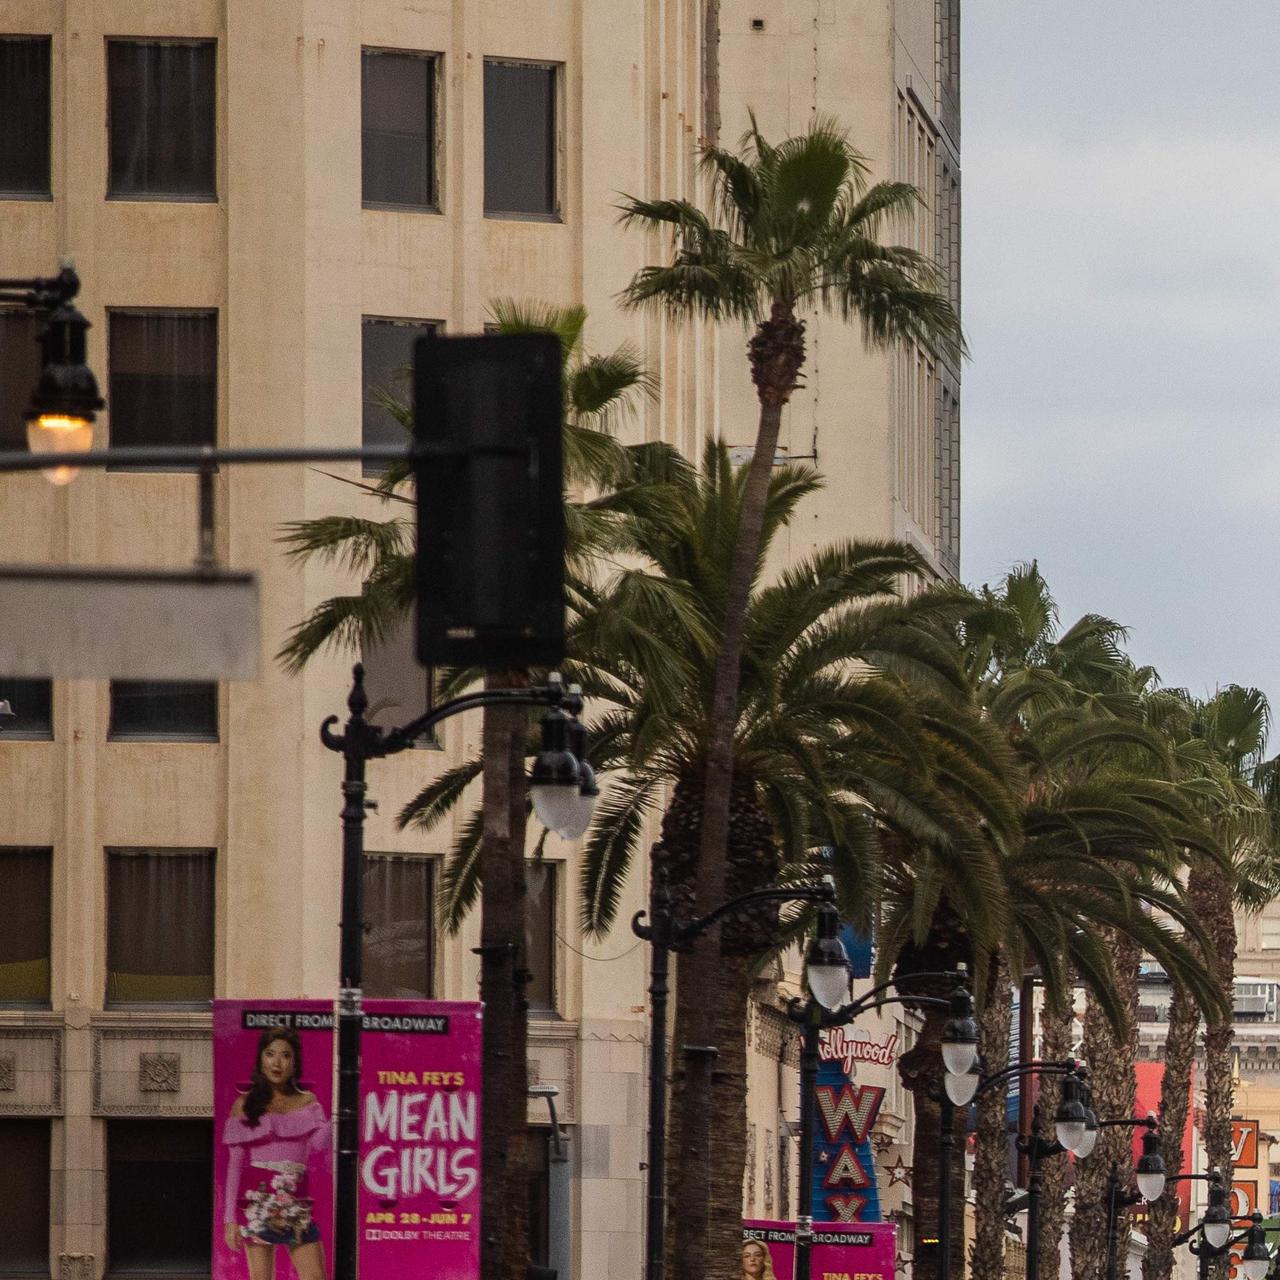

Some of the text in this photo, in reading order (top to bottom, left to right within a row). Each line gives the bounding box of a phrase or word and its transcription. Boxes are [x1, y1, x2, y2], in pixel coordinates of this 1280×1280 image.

[246, 1013, 446, 1032] DIRECT FROM BROADWAY
[816, 1027, 897, 1073] ollywood
[377, 1071, 465, 1087] TINA FEY'S
[364, 1090, 477, 1143] MEAN
[362, 1146, 478, 1200] GIRLS
[366, 1212, 396, 1225] APR
[461, 1213, 472, 1225] 7
[382, 1230, 471, 1241] DOLBY THEATRE
[768, 1232, 796, 1243] FROM
[811, 1233, 871, 1244] BROADWAY
